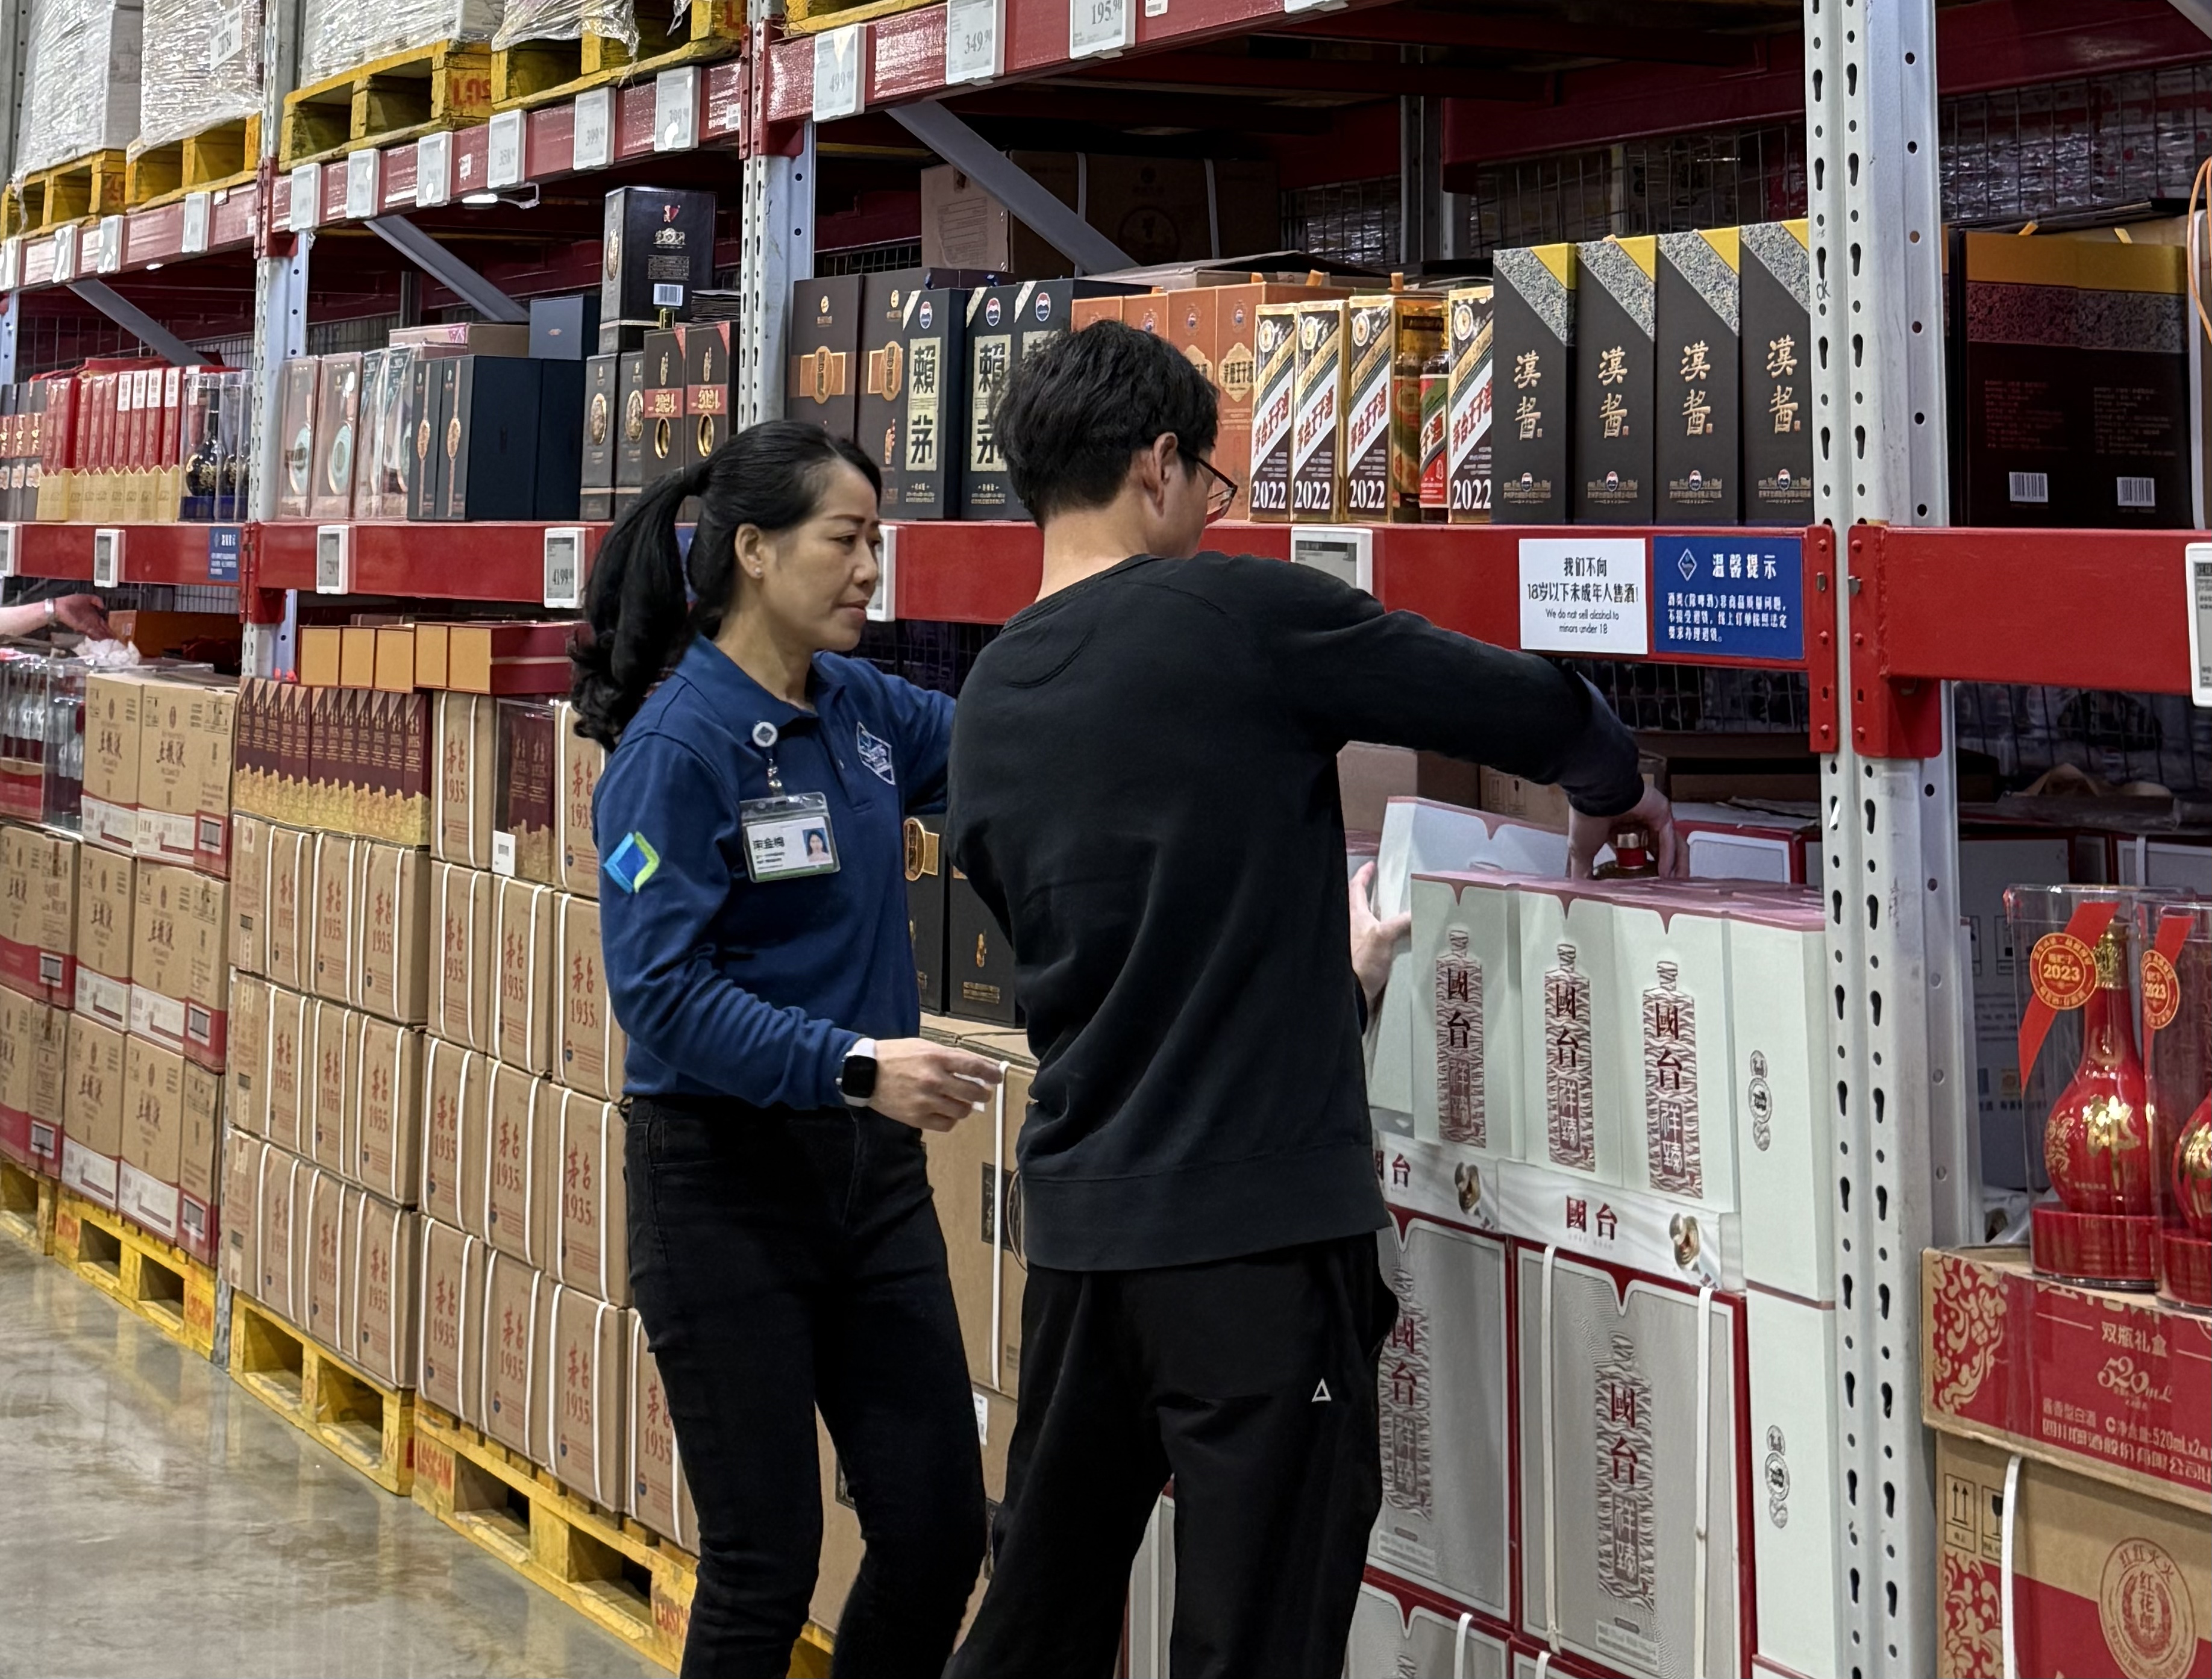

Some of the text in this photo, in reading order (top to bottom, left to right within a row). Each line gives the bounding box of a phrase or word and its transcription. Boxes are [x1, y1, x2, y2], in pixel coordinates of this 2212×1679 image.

[1252, 481, 1286, 509] 2022
[1294, 480, 1331, 510] 2022
[1349, 480, 1385, 508] 2022
[1452, 479, 1491, 510] 2022
[1564, 557, 1607, 577] 我们不向
[1712, 553, 1777, 580] 温馨提示
[1546, 608, 1556, 619] We
[1558, 608, 1565, 619] do
[1567, 609, 1577, 619] not
[1579, 609, 1588, 620] sell
[1613, 610, 1620, 621] to
[1579, 623, 1597, 633] under
[1600, 623, 1608, 634] 18
[571, 803, 592, 830] 193
[2043, 963, 2080, 981] 2023
[1447, 968, 1471, 1049] 國台
[1556, 984, 1579, 1068] 國台
[1656, 1002, 1682, 1090] 國台
[1566, 1195, 1618, 1240] 國台
[1611, 1383, 1638, 1485] 國台
